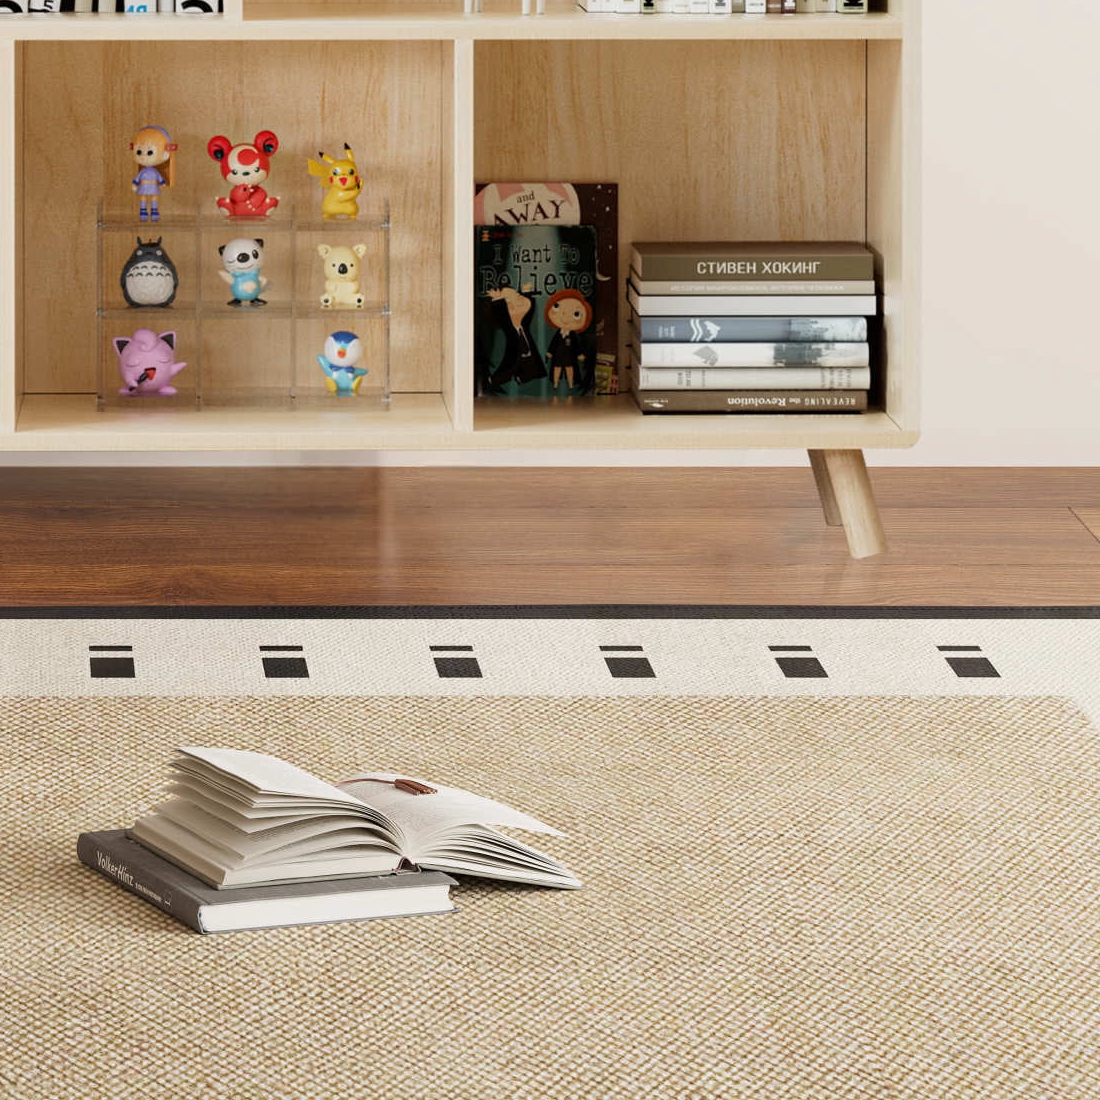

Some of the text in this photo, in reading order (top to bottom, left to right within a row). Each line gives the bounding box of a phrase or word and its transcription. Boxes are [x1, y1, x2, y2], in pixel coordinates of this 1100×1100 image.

[516, 190, 535, 203] and
[493, 200, 565, 226] AWAY
[509, 243, 552, 263] Want
[560, 244, 580, 264] To
[696, 261, 821, 275] СТИВЕН ХОКИНГ
[480, 265, 593, 297] Believe
[727, 396, 786, 406] Revolution
[804, 397, 856, 406] REVEALING
